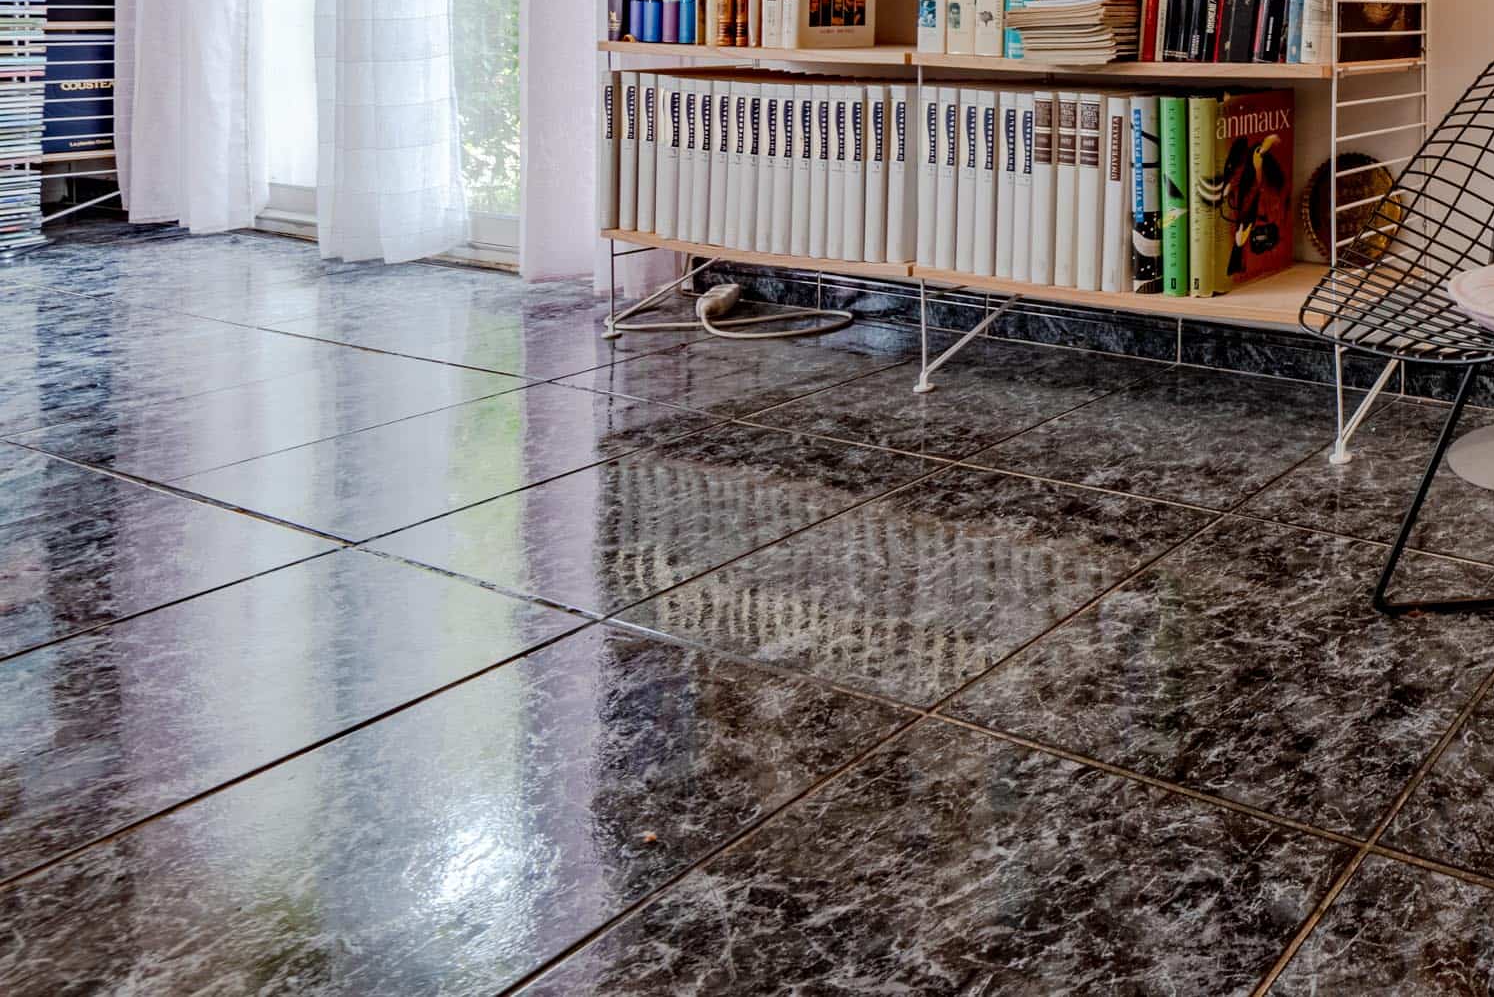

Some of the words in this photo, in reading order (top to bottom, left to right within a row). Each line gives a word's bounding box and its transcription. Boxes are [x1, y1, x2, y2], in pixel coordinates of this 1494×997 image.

[60, 79, 117, 91] COUSTEA
[1216, 107, 1293, 141] animaux
[1110, 116, 1121, 180] UNIVERSALIA
